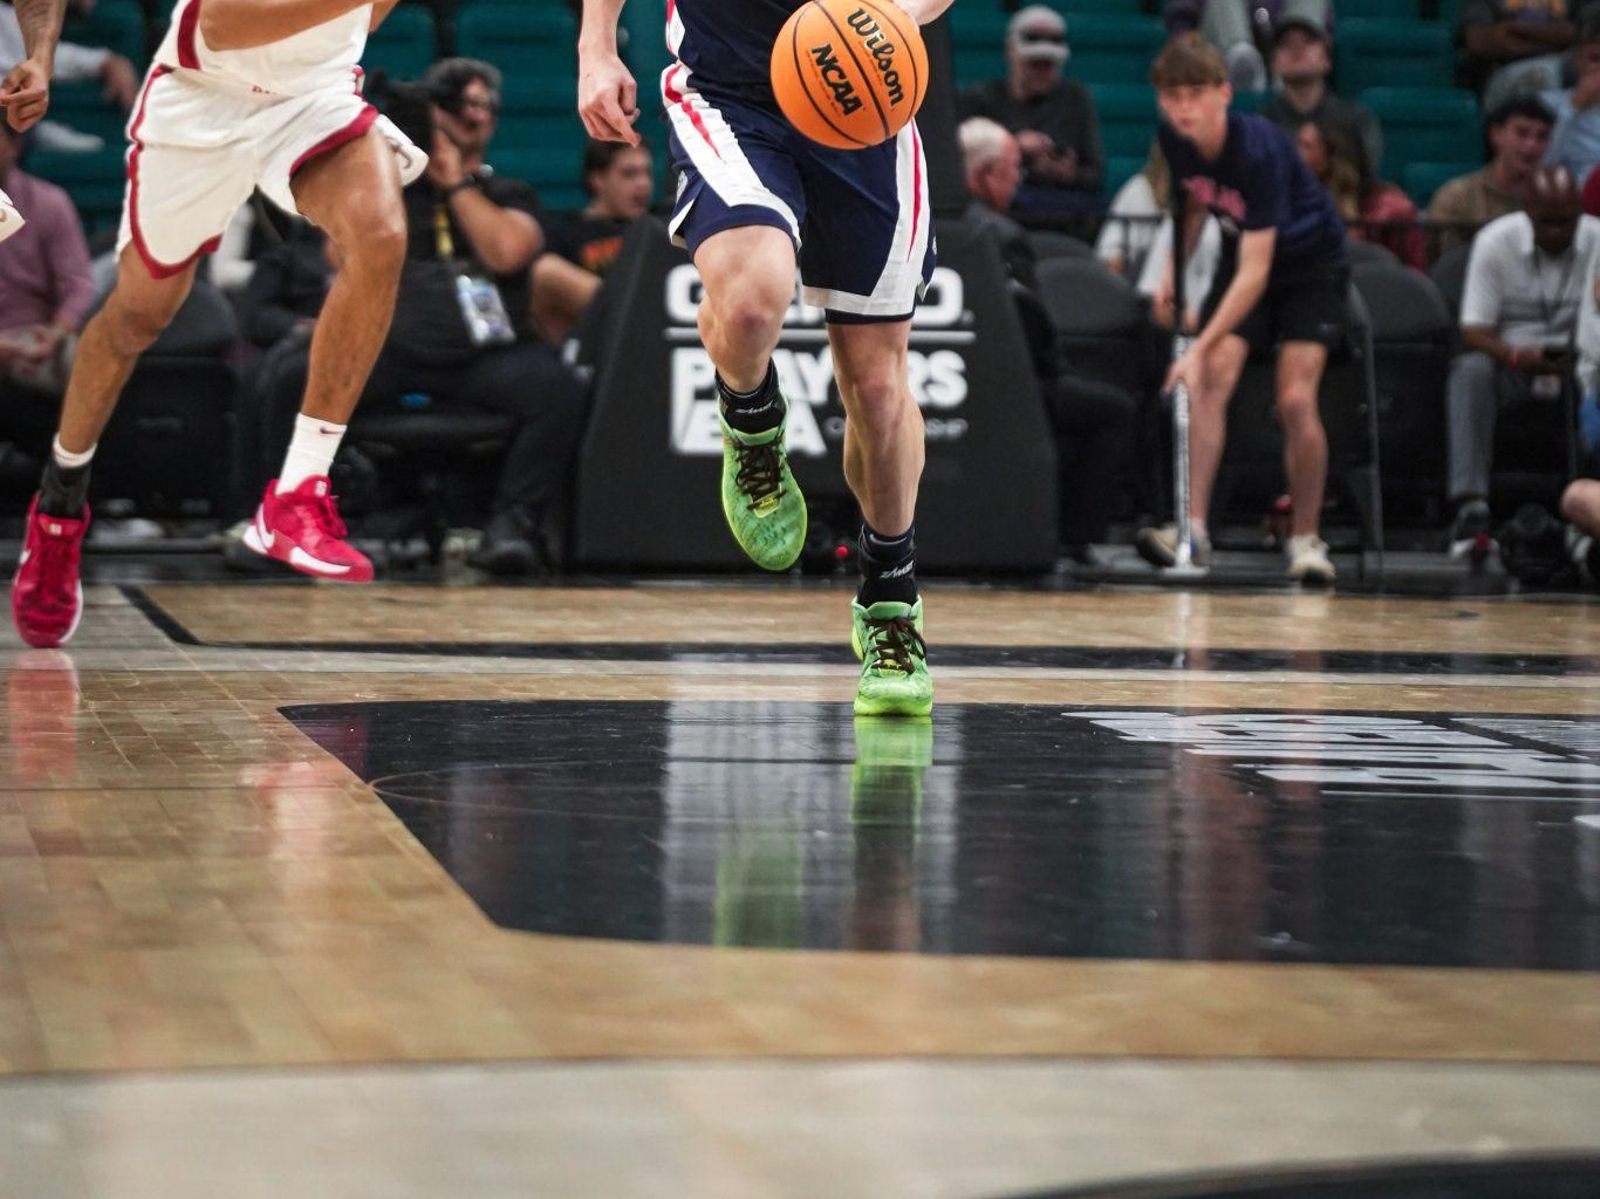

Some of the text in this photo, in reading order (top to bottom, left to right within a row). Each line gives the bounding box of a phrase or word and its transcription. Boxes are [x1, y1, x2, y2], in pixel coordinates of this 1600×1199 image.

[811, 43, 863, 117] NCAA
[847, 7, 904, 107] Wilson
[671, 347, 969, 408] PAYRS
